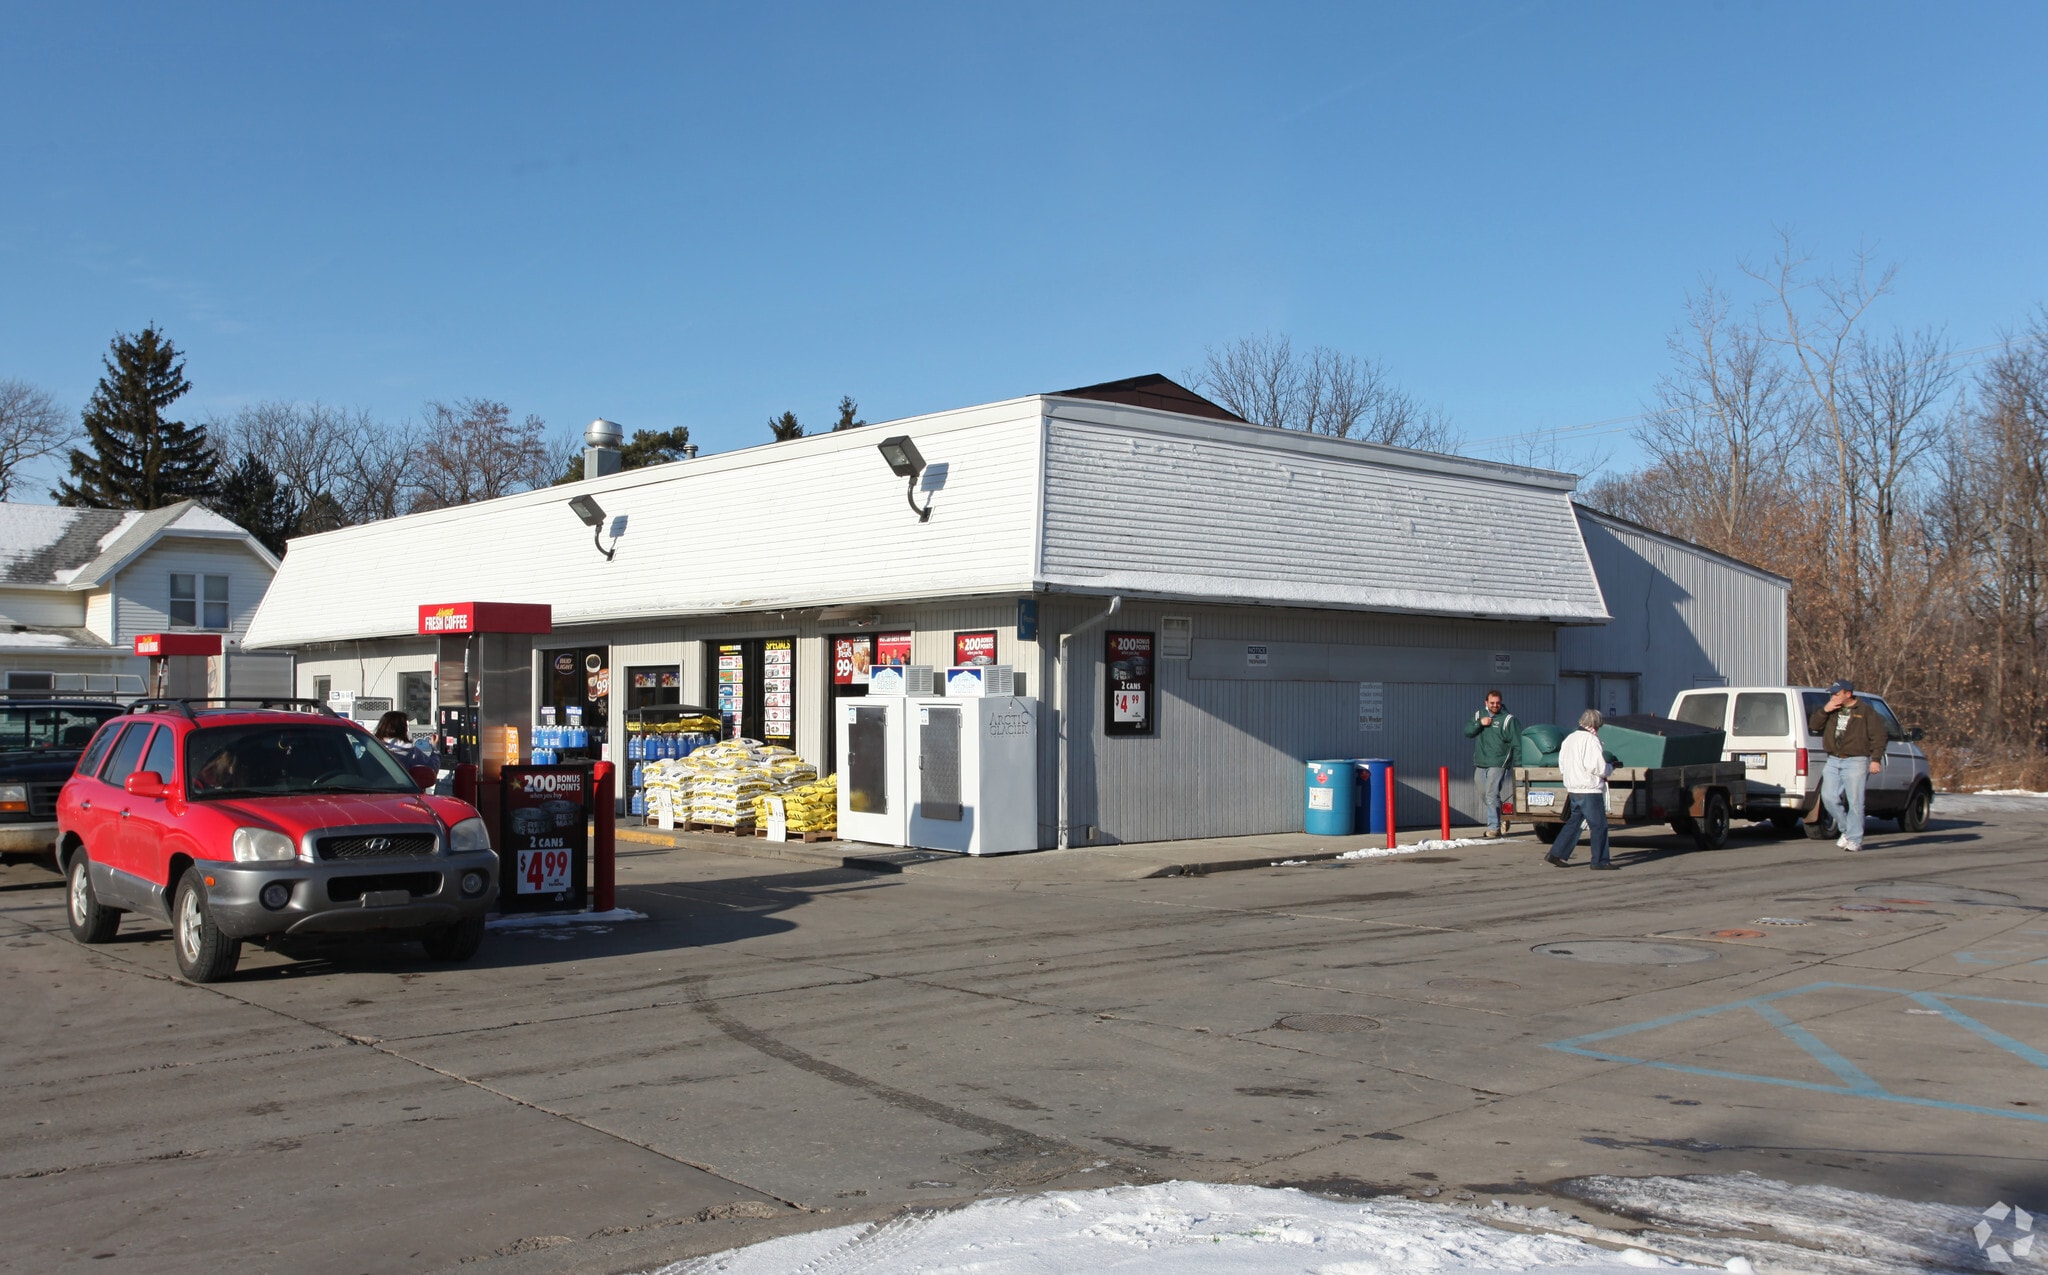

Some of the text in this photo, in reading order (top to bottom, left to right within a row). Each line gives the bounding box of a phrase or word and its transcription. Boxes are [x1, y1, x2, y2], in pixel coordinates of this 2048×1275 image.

[425, 614, 467, 630] FRESH COFFEE
[964, 638, 980, 651] 200
[1118, 638, 1136, 651] 200
[1121, 681, 1126, 690] 2
[989, 711, 1029, 726] ARCTIC
[989, 725, 1029, 736] GLACIER
[524, 775, 580, 792] 200 BONUS
[556, 783, 580, 791] POINTS
[530, 836, 563, 848] 2 CANS
